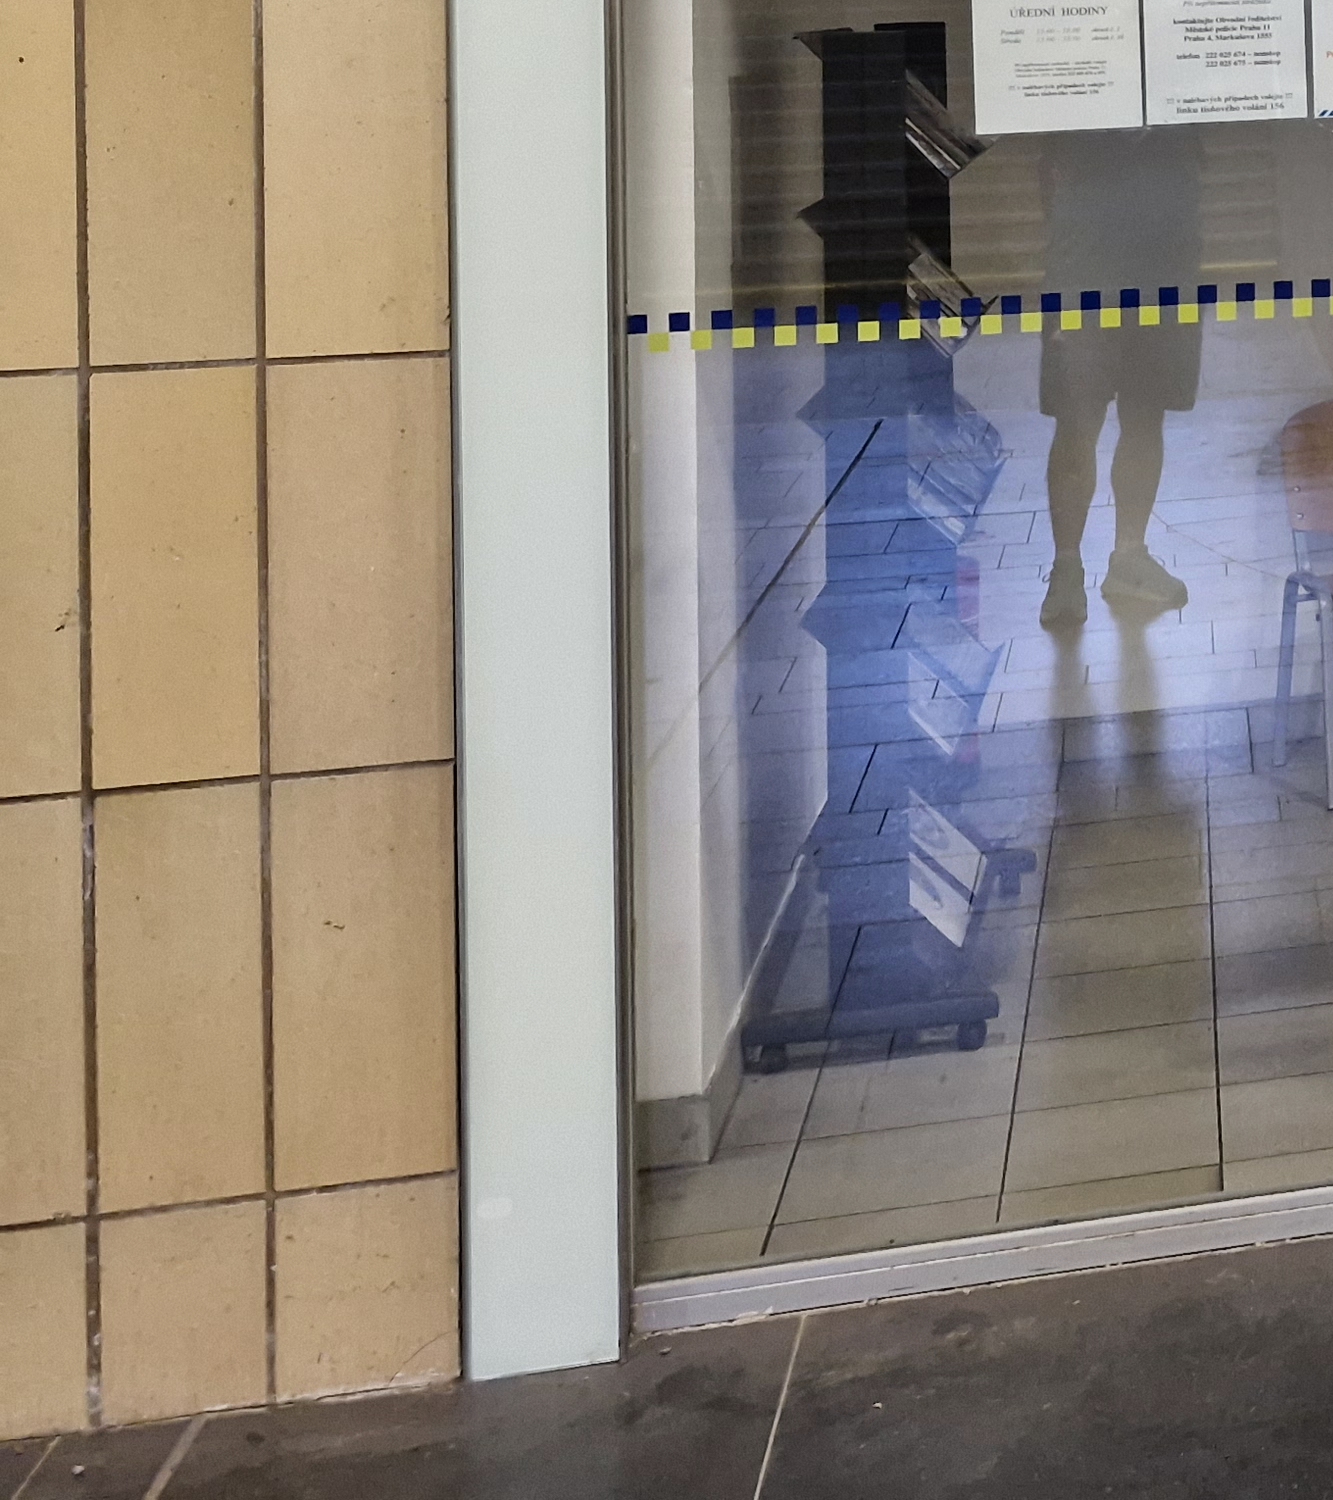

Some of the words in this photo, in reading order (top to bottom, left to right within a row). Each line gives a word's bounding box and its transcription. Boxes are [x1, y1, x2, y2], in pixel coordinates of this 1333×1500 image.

[1010, 6, 1055, 18] ÚŘEDNÍ
[1062, 7, 1108, 17] HODINY
[1270, 102, 1285, 110] 156
